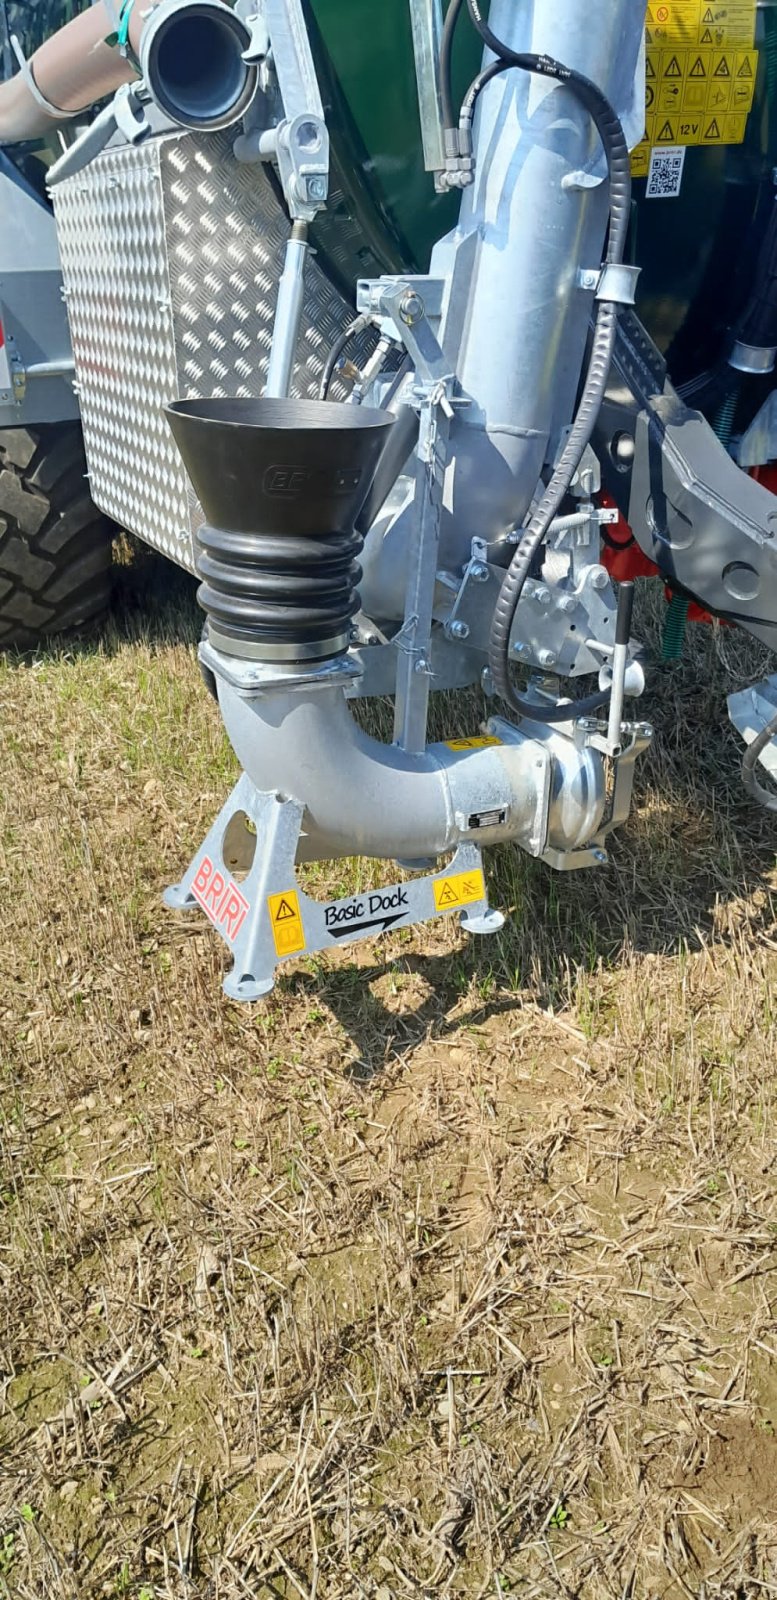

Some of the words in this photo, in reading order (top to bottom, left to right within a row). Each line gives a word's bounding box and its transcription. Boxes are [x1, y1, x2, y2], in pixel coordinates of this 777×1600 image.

[680, 124, 690, 135] 12
[691, 124, 699, 135] V
[191, 856, 249, 941] BRIRI
[324, 898, 364, 926] Basic
[368, 886, 409, 914] Dock
